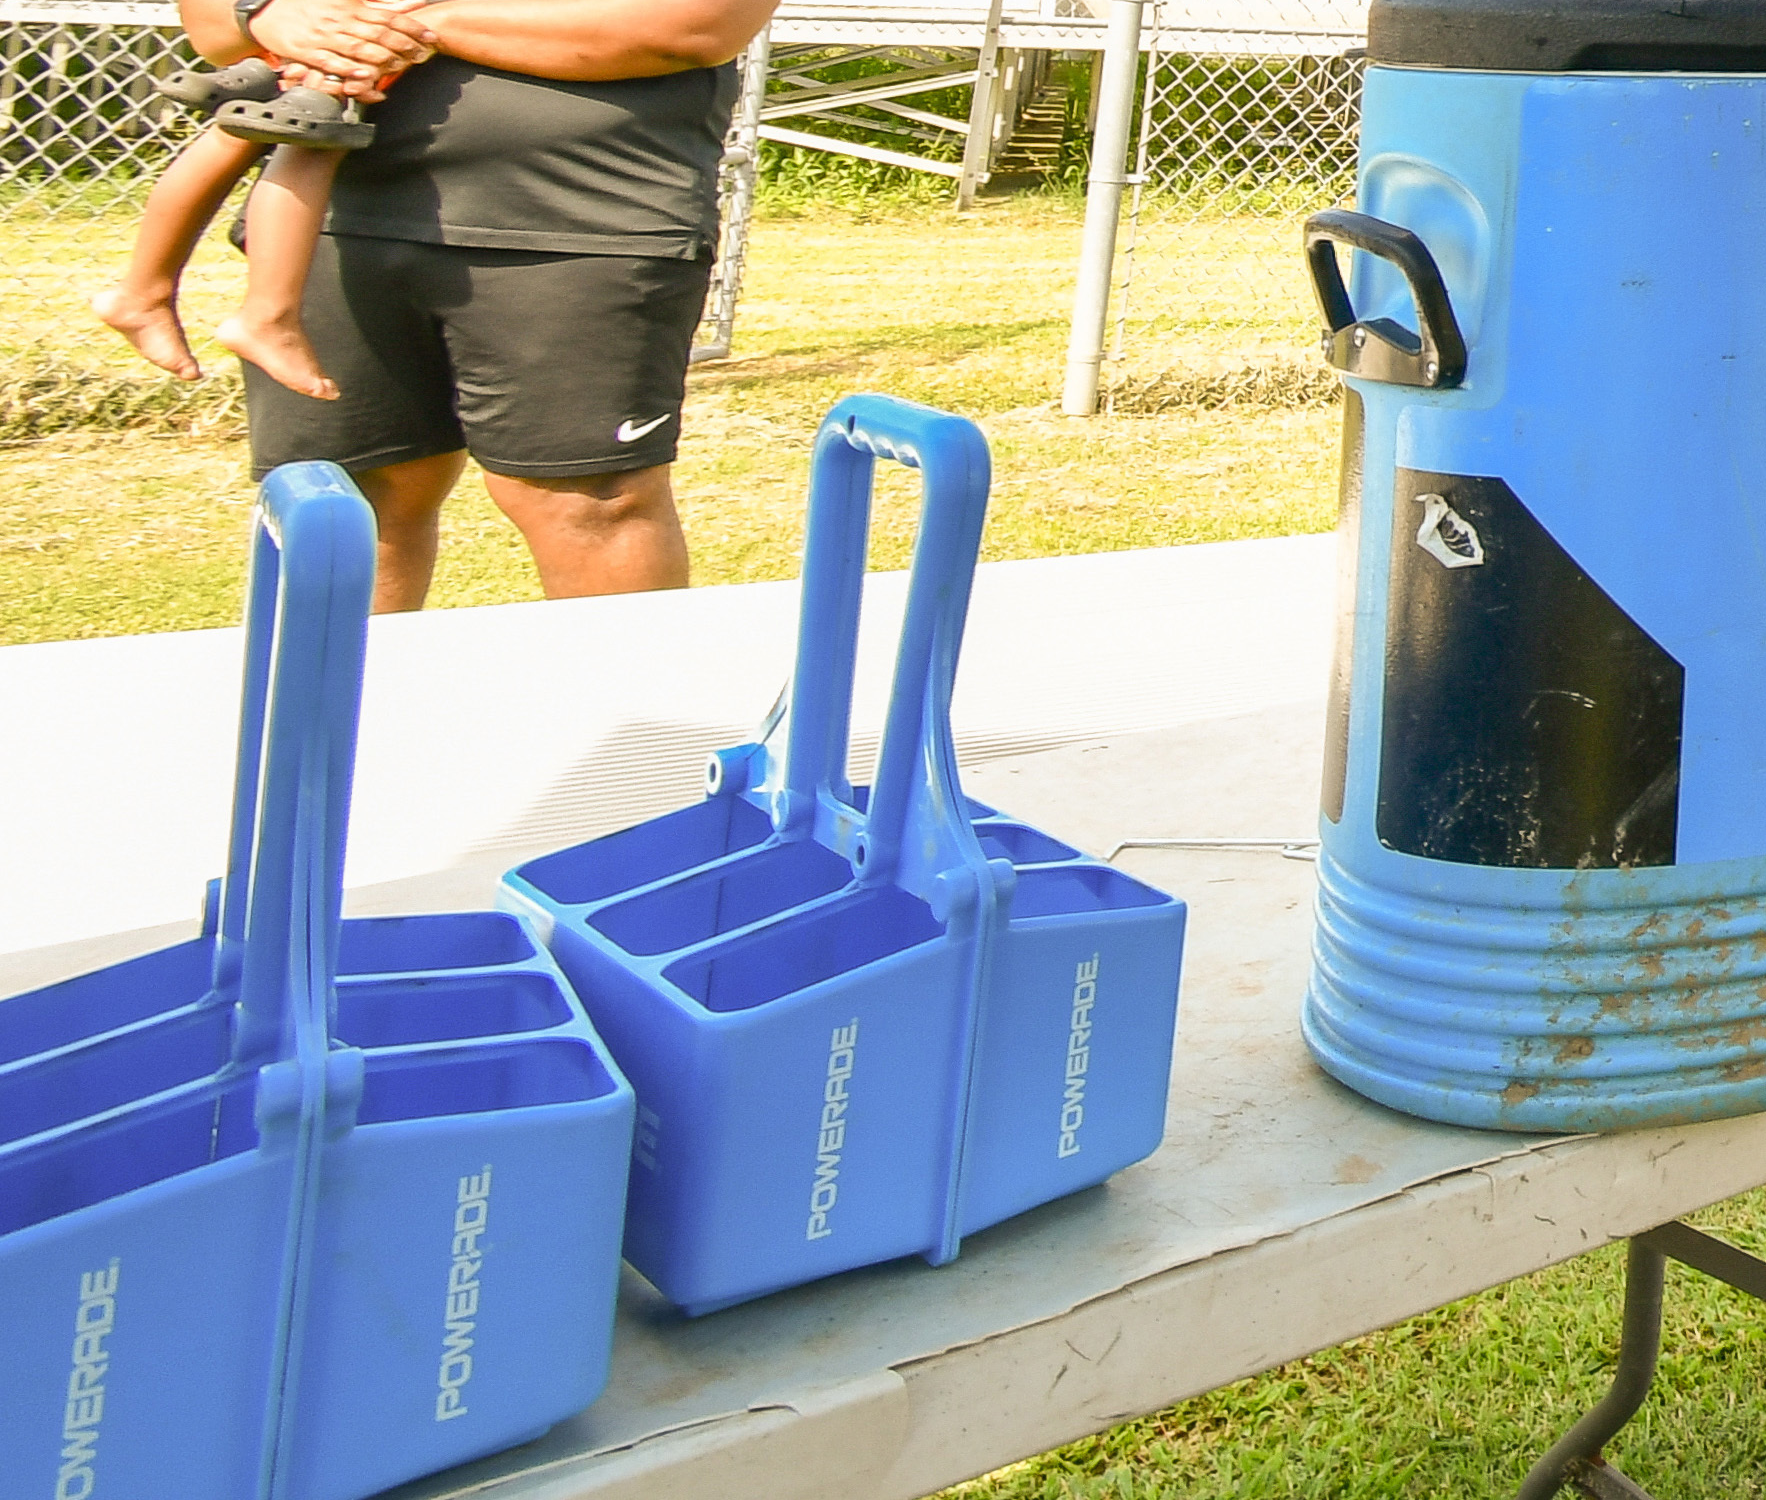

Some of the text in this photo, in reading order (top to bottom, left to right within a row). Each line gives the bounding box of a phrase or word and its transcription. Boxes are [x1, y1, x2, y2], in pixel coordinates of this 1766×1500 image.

[806, 1024, 858, 1241] POWERADE
[1058, 959, 1099, 1159] POWERADE
[55, 1266, 119, 1500] OWERADE
[435, 1168, 491, 1422] POWERADE
